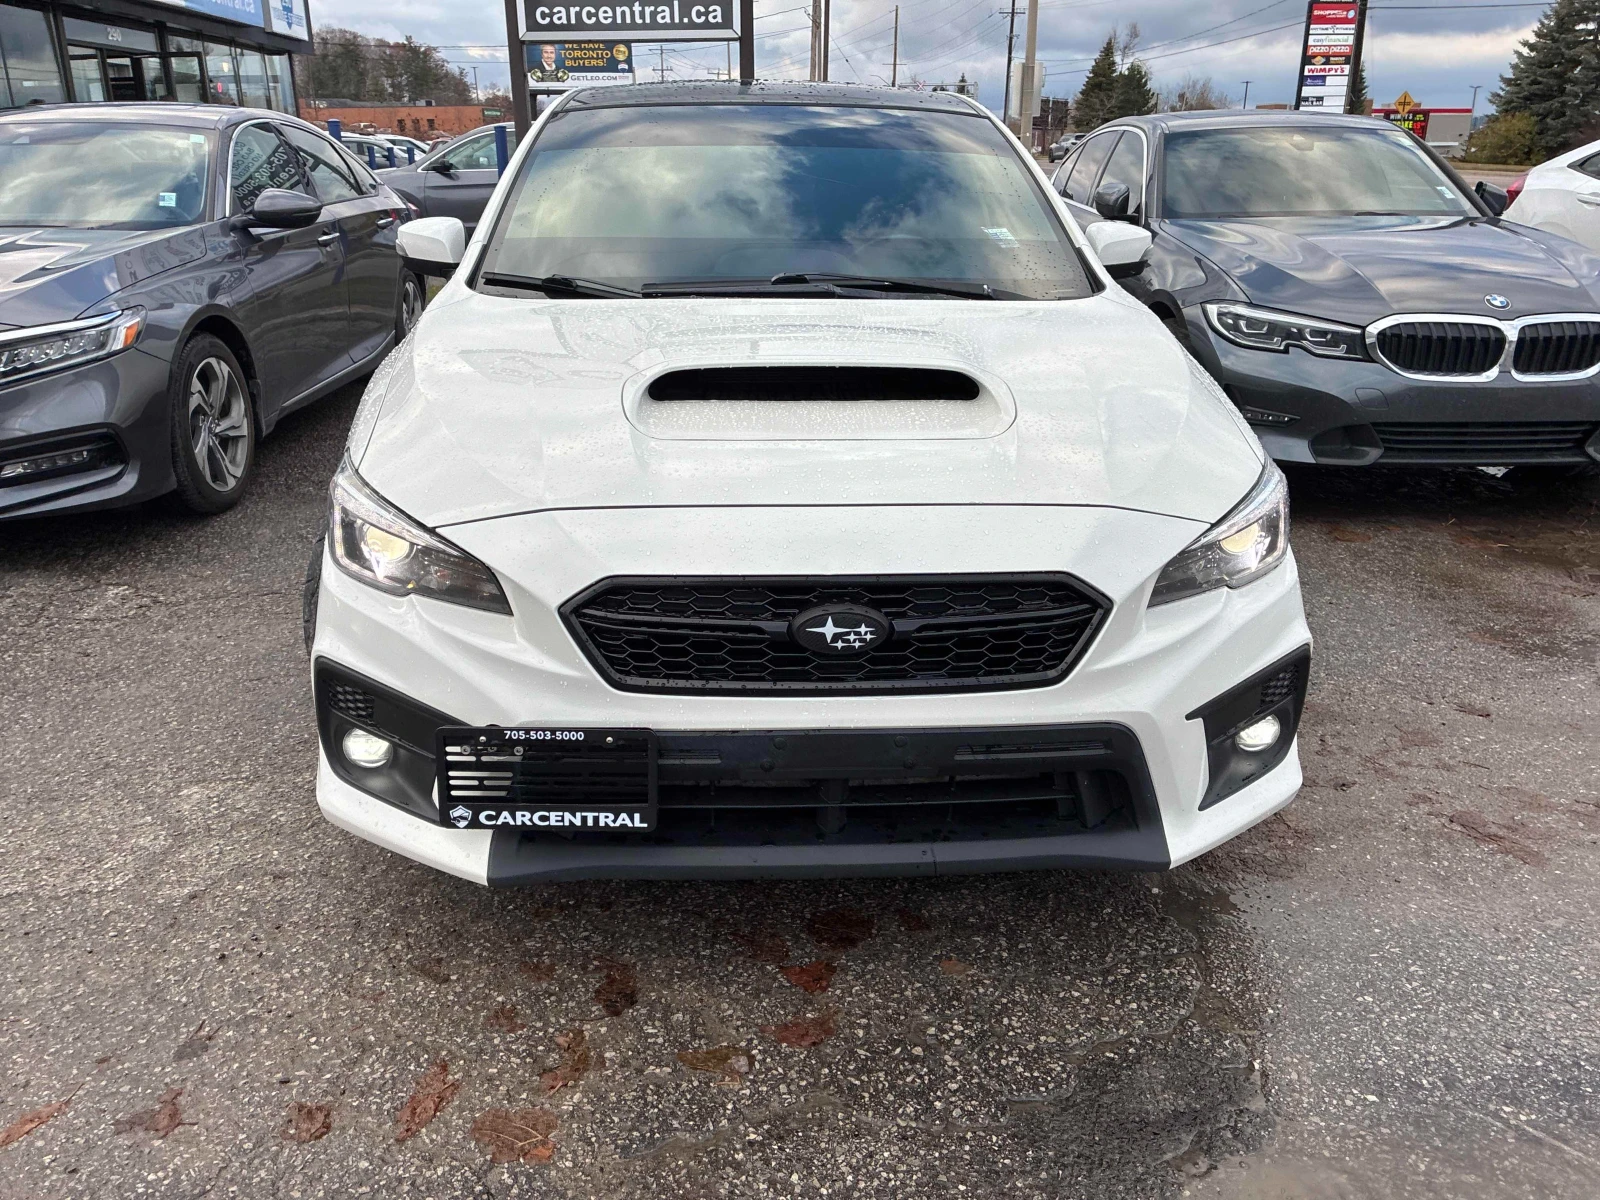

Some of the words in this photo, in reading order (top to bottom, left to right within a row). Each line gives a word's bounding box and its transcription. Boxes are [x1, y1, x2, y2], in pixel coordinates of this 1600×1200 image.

[535, 0, 723, 25] carcentral.ca
[560, 50, 611, 58] TORONTO
[564, 58, 607, 67] BUYERS!
[1307, 66, 1346, 74] WIMPY'S
[503, 730, 585, 741] 705-503-5000
[478, 810, 648, 828] CARCENTRAL
